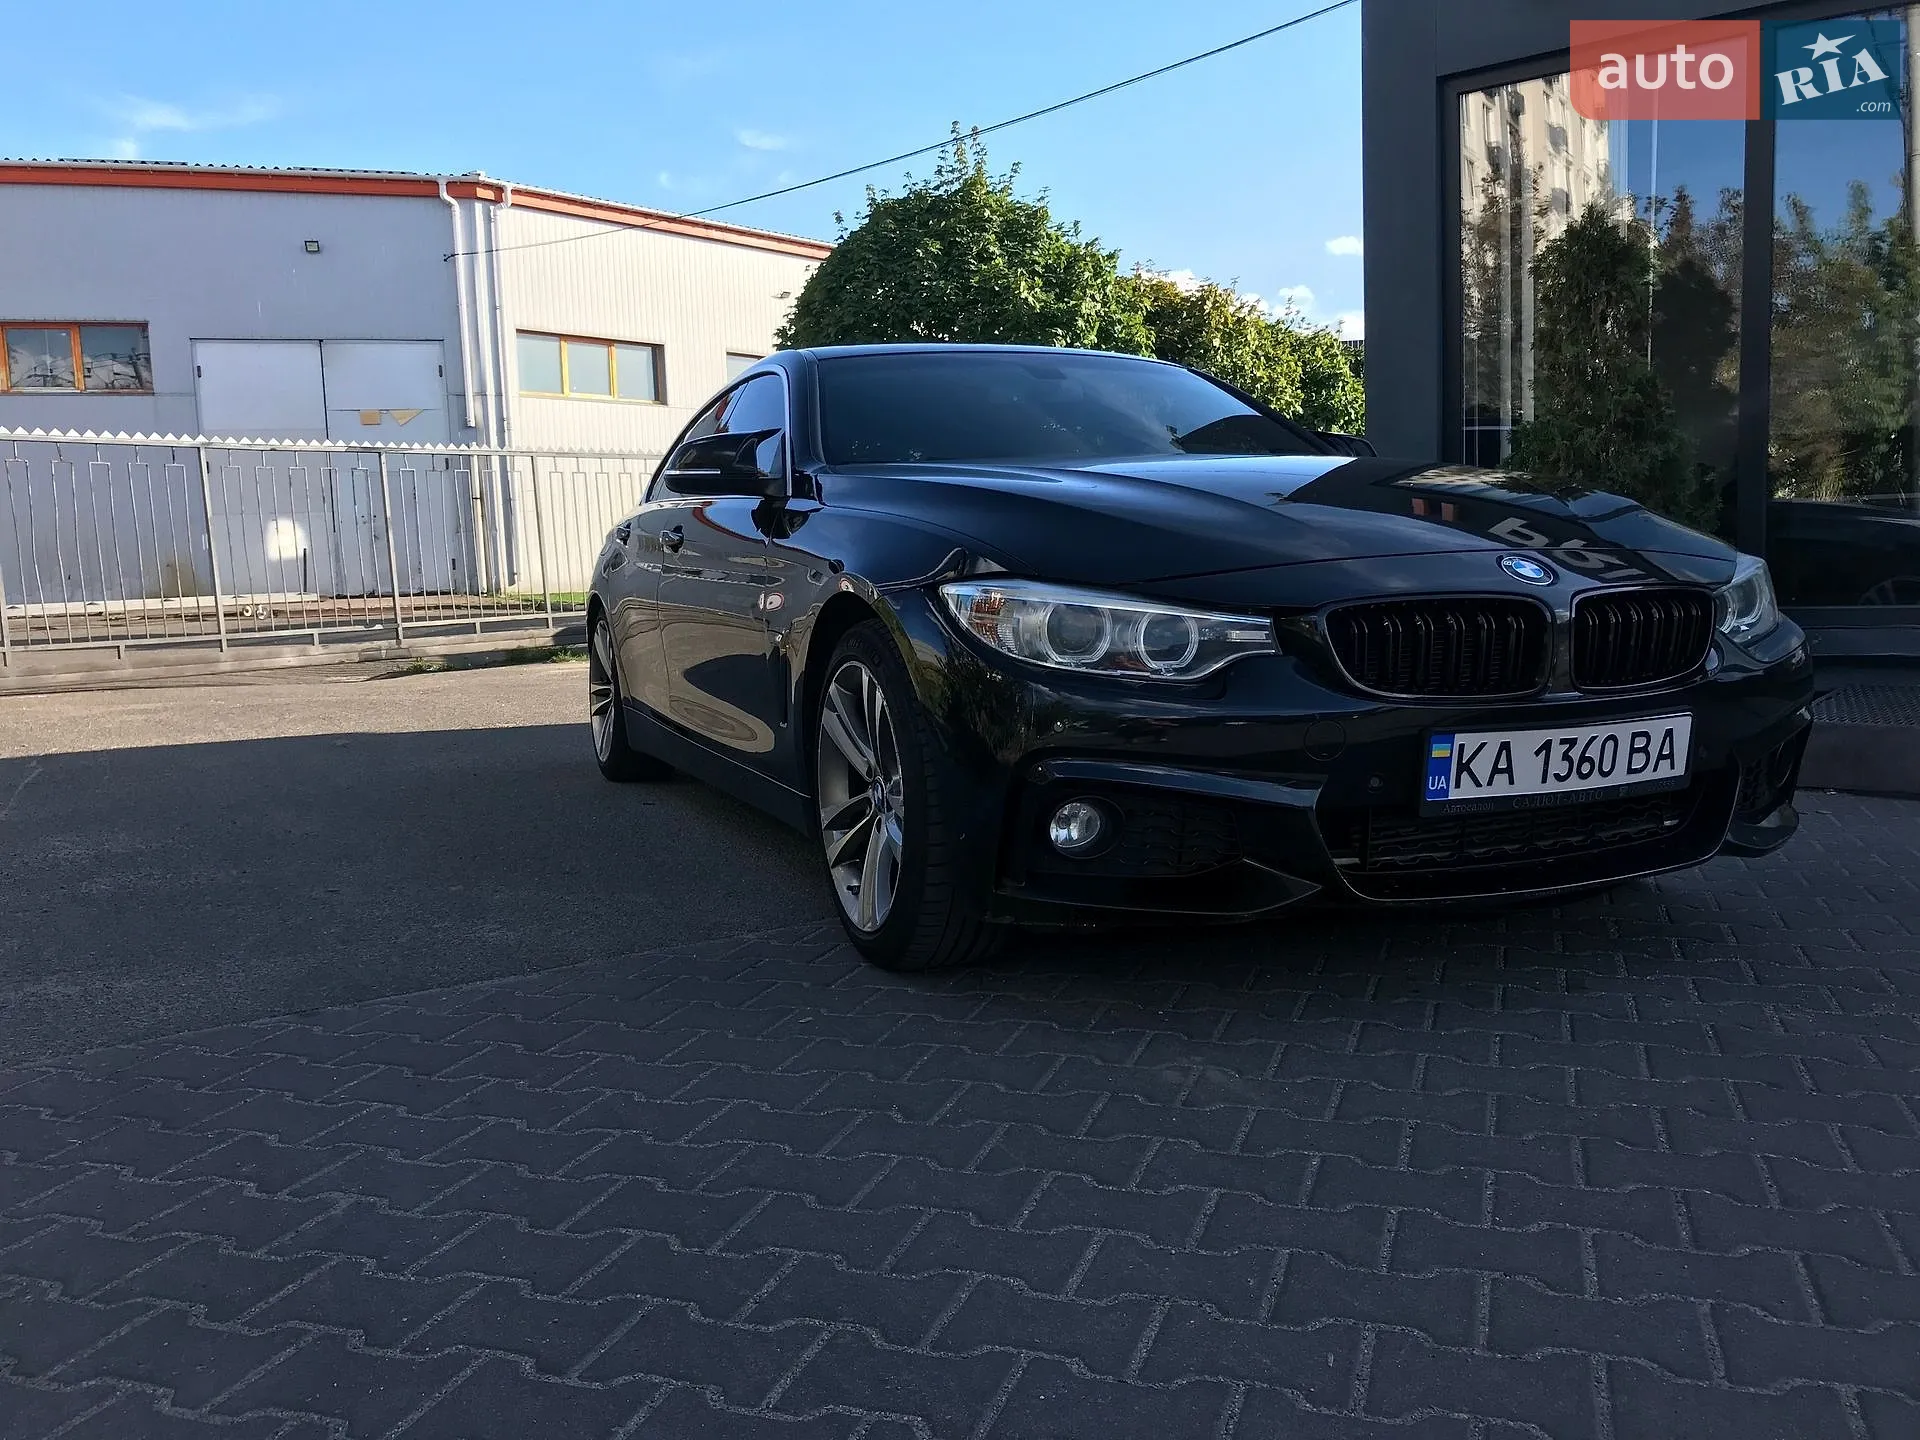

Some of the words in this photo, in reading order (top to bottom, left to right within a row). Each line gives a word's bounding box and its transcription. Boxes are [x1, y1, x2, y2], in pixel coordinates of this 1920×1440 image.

[1453, 739, 1516, 789] KA
[1533, 733, 1619, 785] 1360
[1626, 726, 1676, 775] BA
[1428, 776, 1447, 790] UA
